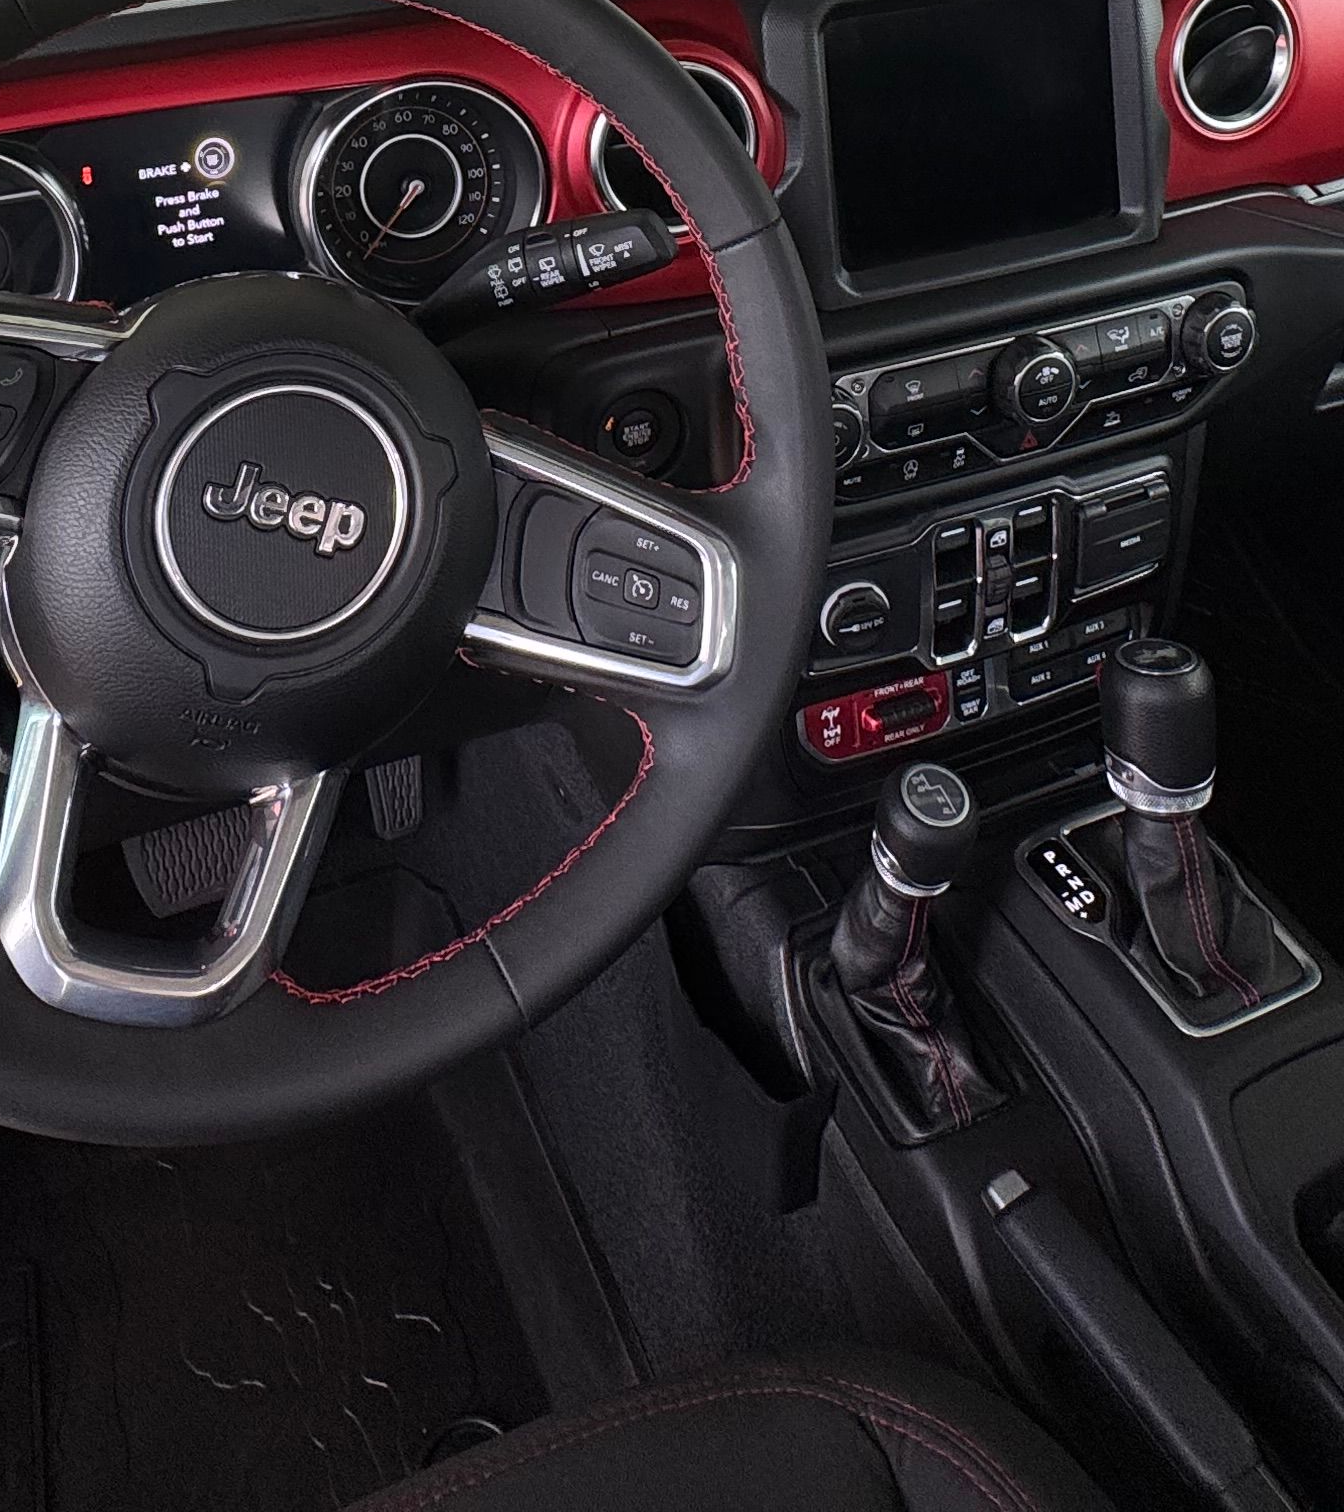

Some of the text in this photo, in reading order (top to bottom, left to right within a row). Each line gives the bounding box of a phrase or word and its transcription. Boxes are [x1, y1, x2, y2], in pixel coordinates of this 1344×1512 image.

[394, 109, 412, 123] 60
[422, 114, 436, 125] 70
[372, 120, 387, 132] 50
[442, 123, 459, 135] 80
[351, 136, 368, 148] 40
[460, 143, 474, 153] 90
[138, 163, 178, 180] BRAKE
[341, 161, 354, 172] 30
[467, 167, 484, 178] 100
[335, 185, 352, 198] 20
[468, 191, 482, 202] 110
[154, 188, 220, 208] Press Brake
[178, 203, 201, 218] and
[345, 211, 356, 221] 10
[458, 213, 475, 225] 120
[157, 216, 225, 236] Push Button
[572, 227, 589, 237] OFF
[172, 231, 214, 248] to Start
[360, 230, 369, 242] 0
[507, 244, 520, 254] ON
[588, 252, 615, 266] FRONT
[591, 260, 618, 273] WIPER
[511, 276, 527, 287] OFF
[1149, 325, 1165, 338] A/C
[1039, 374, 1055, 386] OFF
[1038, 394, 1058, 407] AUTO
[904, 471, 917, 481] OFF
[203, 462, 366, 557] Jeep
[591, 570, 620, 587] CANC
[670, 595, 690, 611] RES
[874, 617, 885, 627] DC
[1085, 622, 1099, 635] AUX
[1029, 642, 1044, 654] AUX
[1087, 653, 1102, 665] AUX
[1031, 673, 1045, 685] AUX
[884, 723, 926, 743] REAR ONLY
[824, 736, 842, 748] OFF
[1043, 850, 1056, 864] P
[1055, 863, 1072, 877] R
[1067, 876, 1084, 890] N
[1079, 890, 1095, 904] D
[1064, 896, 1084, 913] M
